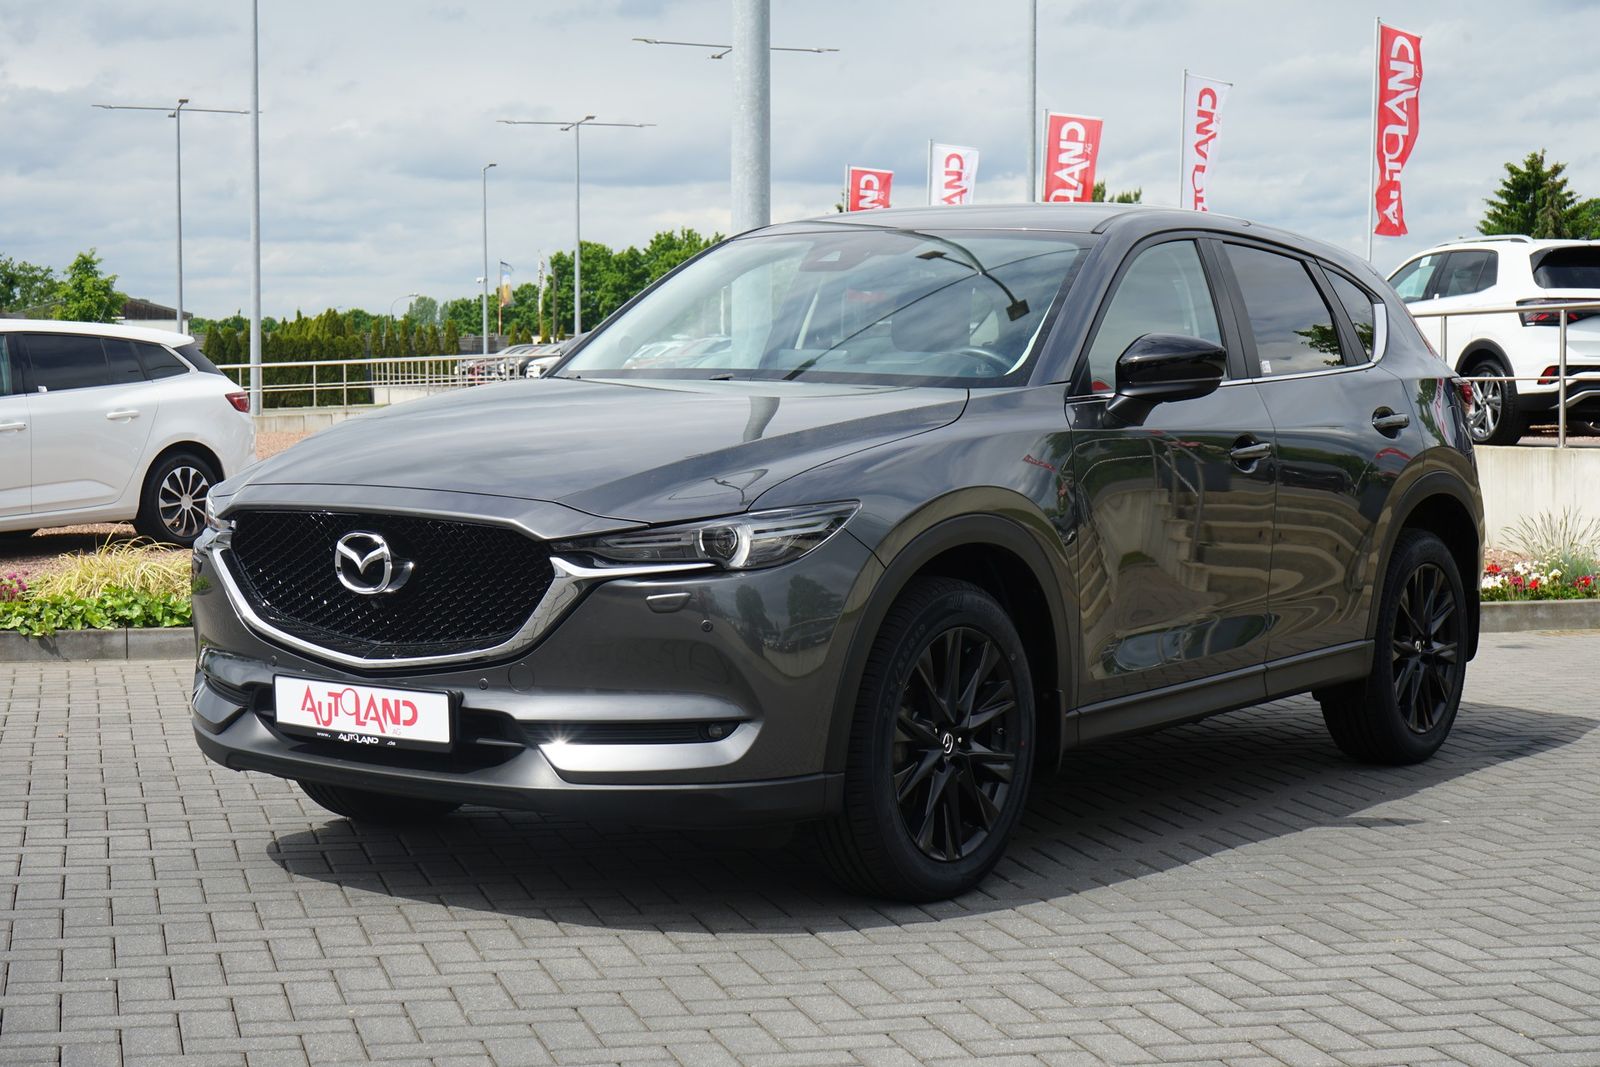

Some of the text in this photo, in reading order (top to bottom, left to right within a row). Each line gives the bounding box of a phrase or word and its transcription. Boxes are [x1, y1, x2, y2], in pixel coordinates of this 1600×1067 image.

[1084, 143, 1093, 155] AG
[859, 174, 883, 208] ND
[301, 684, 418, 734] AUTOLAND
[338, 733, 379, 745] AUTOLAND
